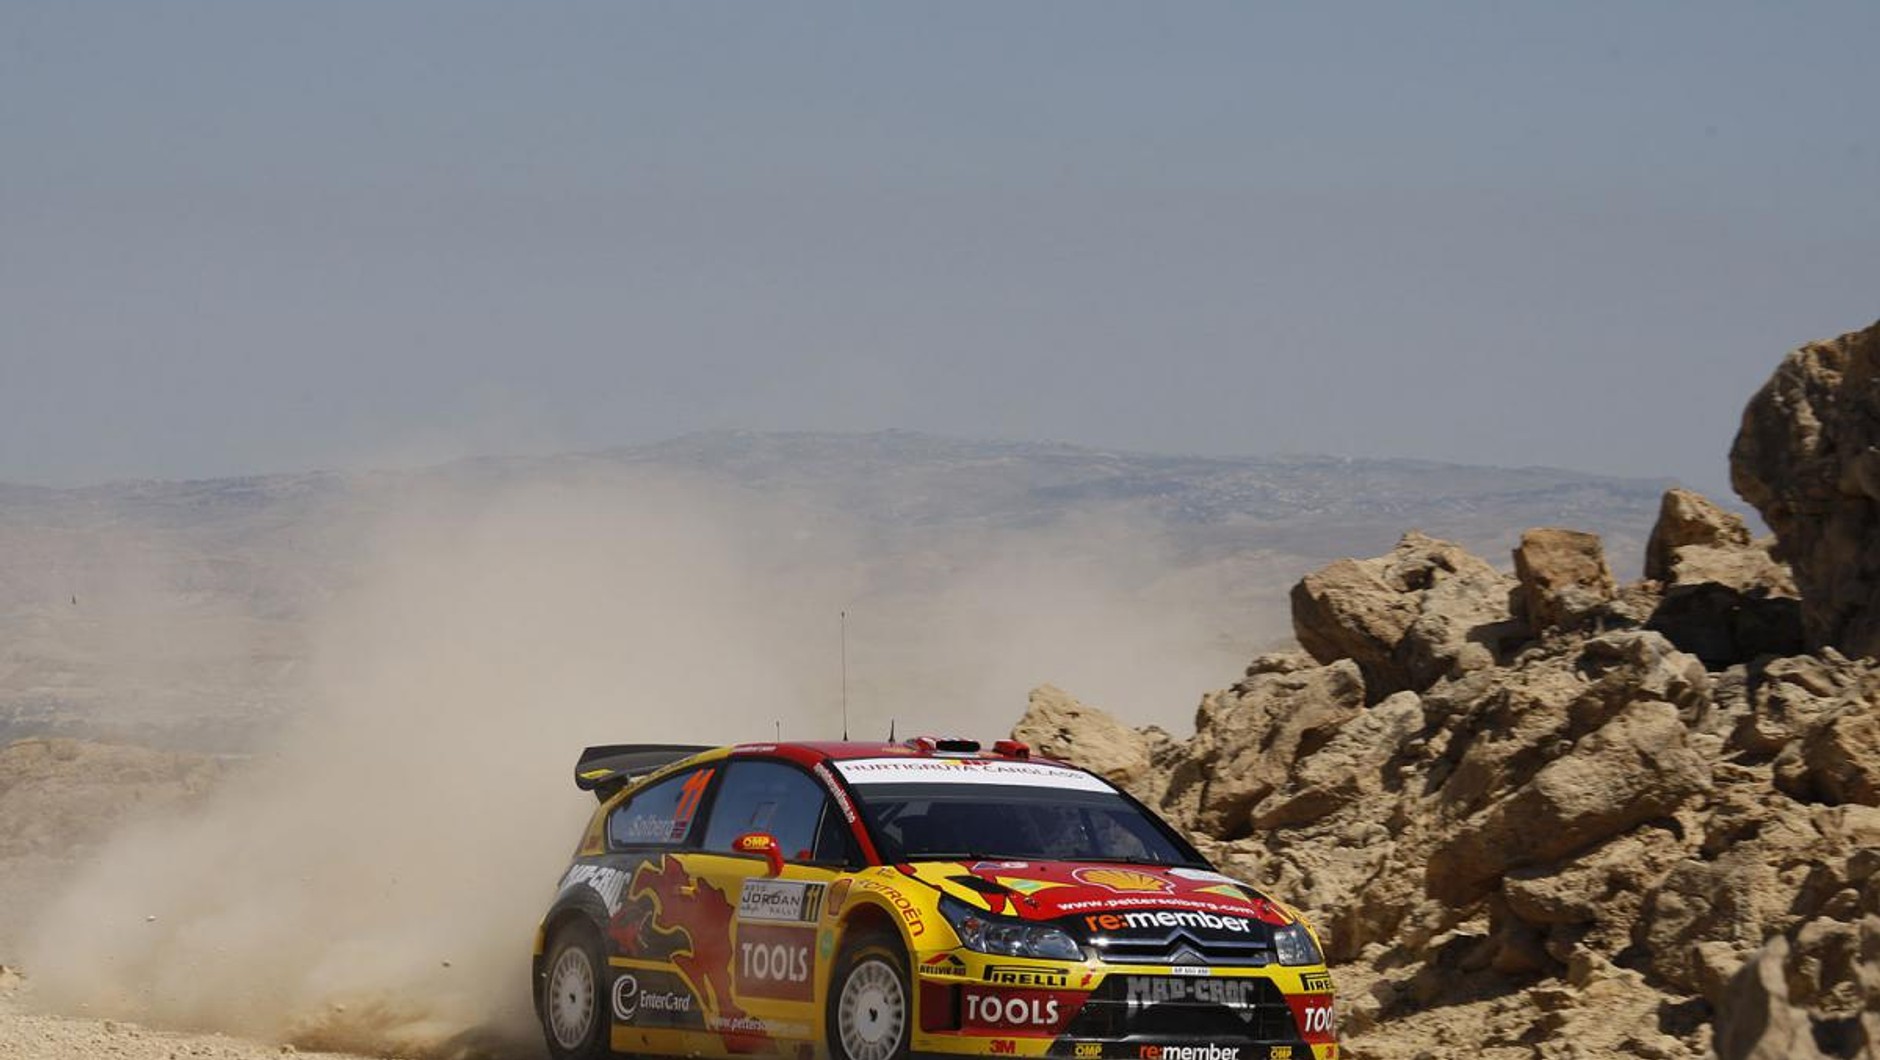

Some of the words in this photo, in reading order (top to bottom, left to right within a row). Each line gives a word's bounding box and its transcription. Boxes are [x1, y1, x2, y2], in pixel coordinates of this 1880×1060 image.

[675, 768, 715, 821] 11
[742, 836, 769, 848] OMP
[742, 891, 801, 905] JORDAN
[806, 885, 822, 921] 11
[1056, 897, 1255, 915] www.pettersolberg.com
[1084, 910, 1251, 933] re:member
[741, 942, 808, 982] TOOLS
[982, 964, 1071, 987] PIRELLI
[639, 989, 691, 1012] EnterCard
[966, 994, 1059, 1024] TOOLS
[1305, 1006, 1333, 1032] TOO
[989, 1040, 1016, 1054] 3M
[1074, 1046, 1102, 1057] OMP
[1139, 1043, 1240, 1060] re:member
[1270, 1048, 1292, 1058] OMP
